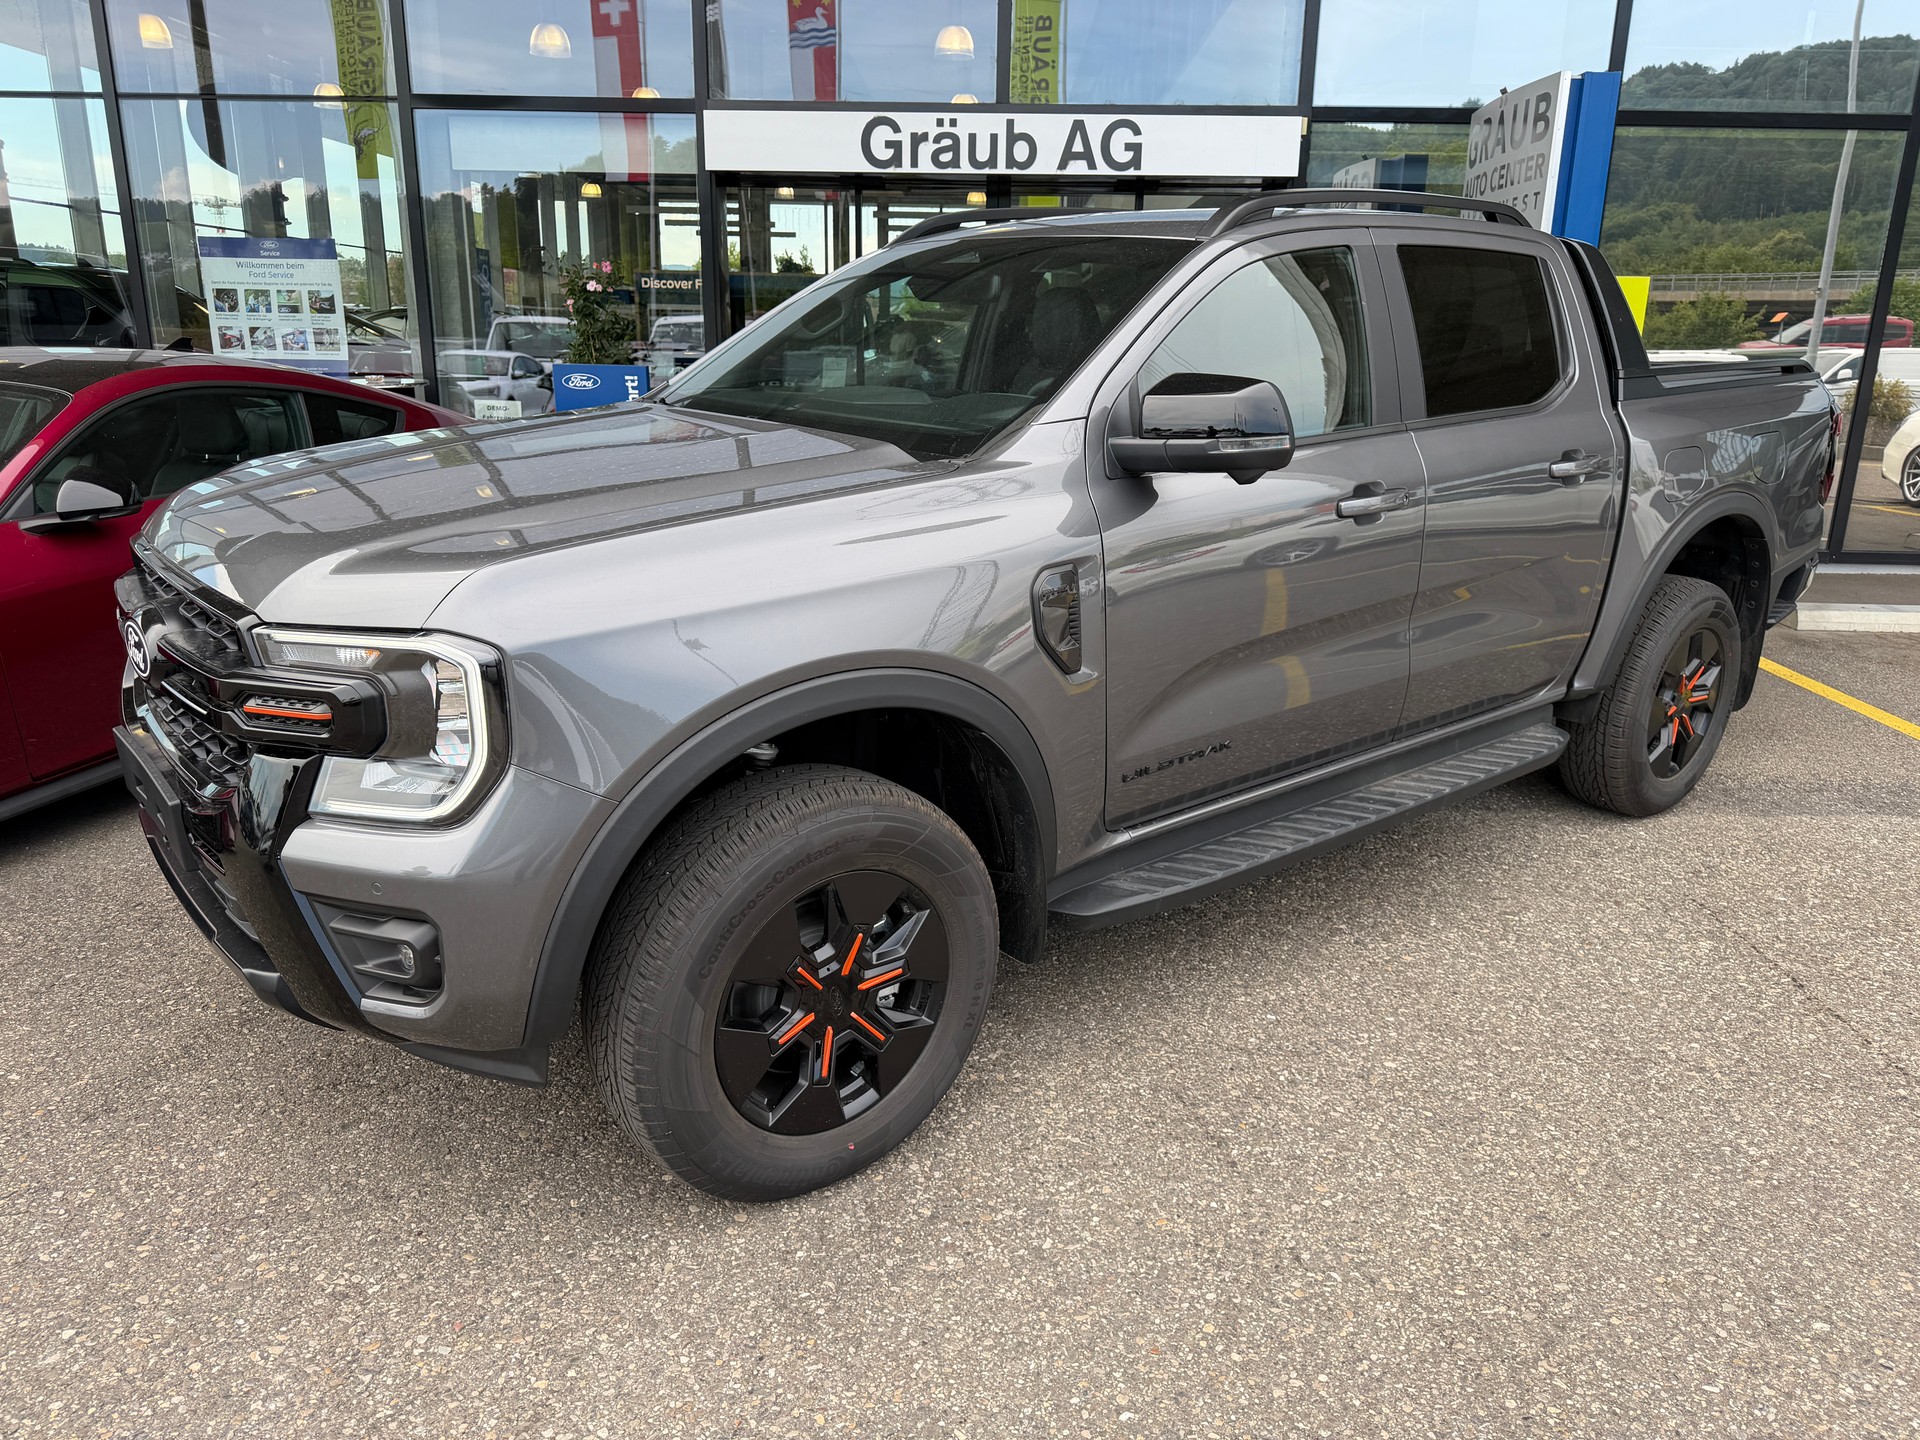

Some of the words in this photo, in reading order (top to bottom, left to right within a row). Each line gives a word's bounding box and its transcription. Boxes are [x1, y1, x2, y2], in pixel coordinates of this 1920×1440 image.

[861, 116, 1038, 171] Gräub
[1057, 118, 1143, 171] AG
[1468, 91, 1552, 170] GRÄUB
[1464, 171, 1488, 199] AUTO
[1490, 152, 1545, 192] CENTER
[235, 261, 285, 270] Willkommen
[286, 261, 305, 270] beim
[248, 271, 267, 279] Ford
[268, 271, 294, 279] Service
[641, 277, 693, 290] Discover
[698, 841, 842, 979] ContiCrossContact
